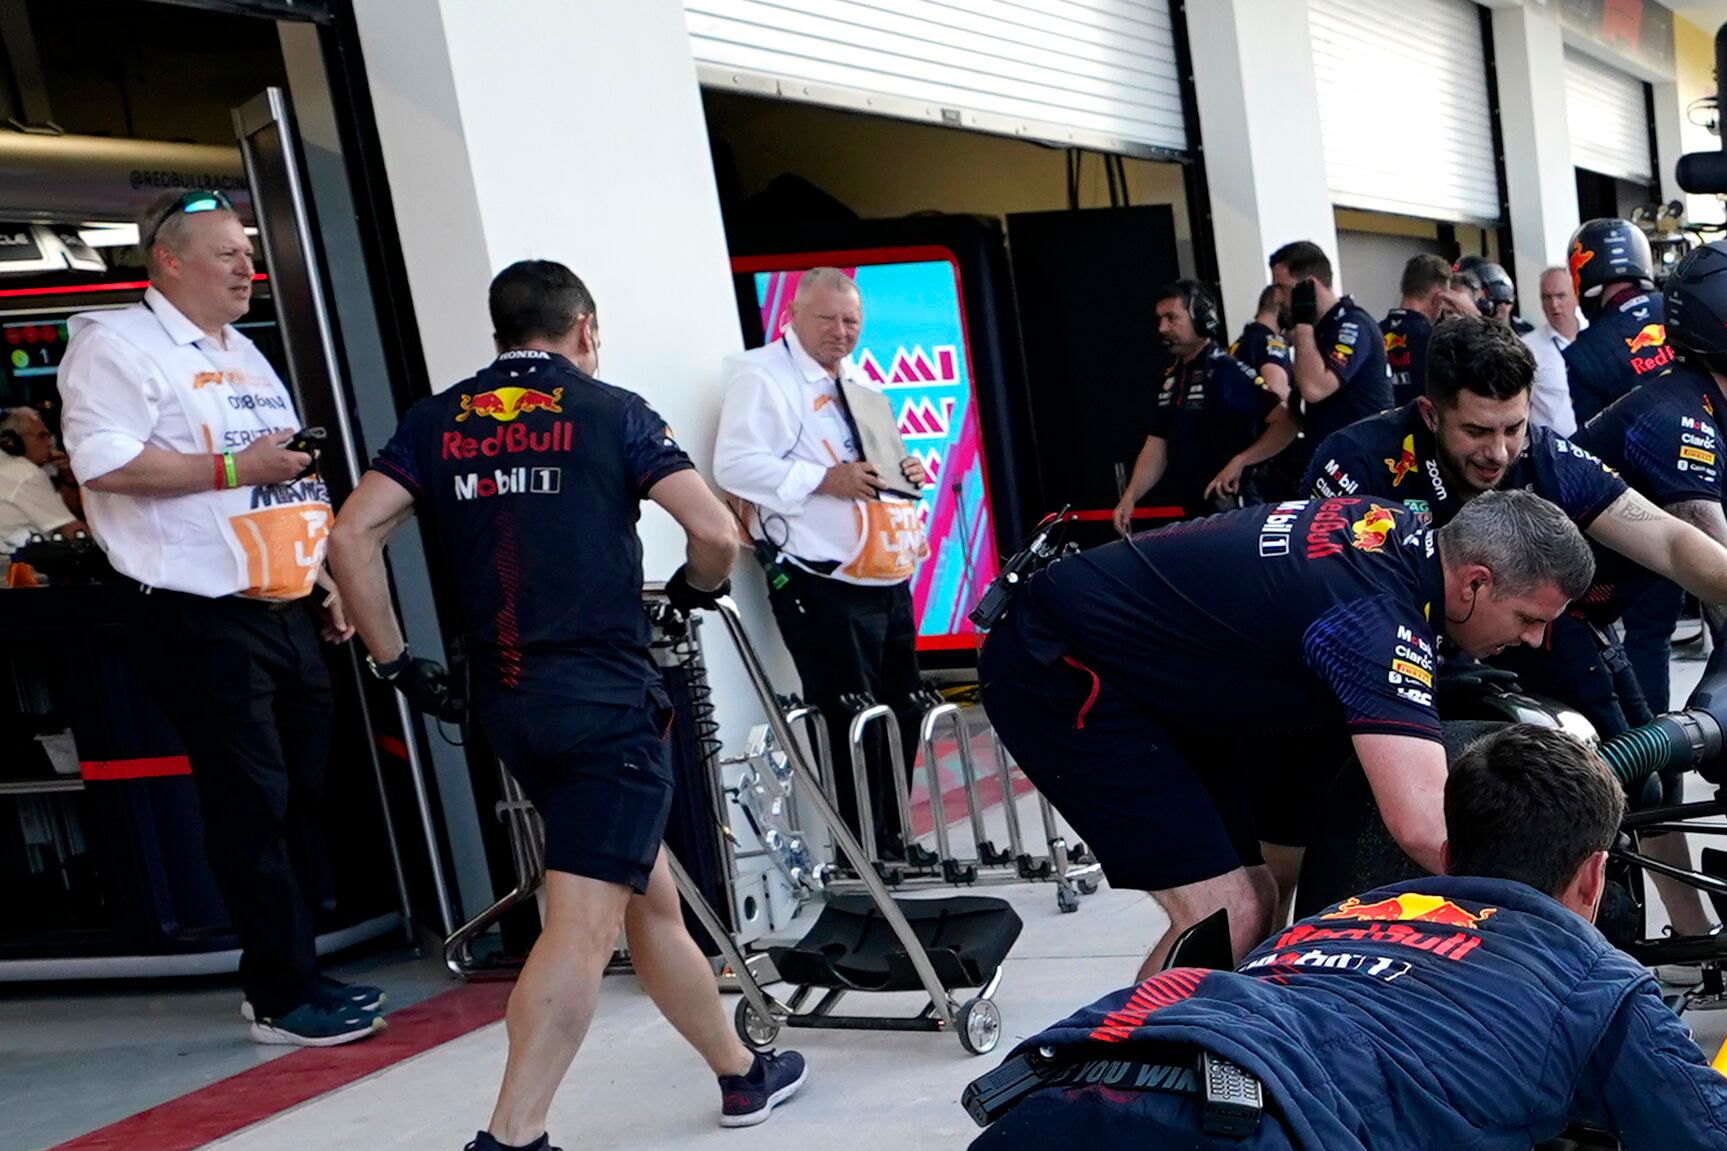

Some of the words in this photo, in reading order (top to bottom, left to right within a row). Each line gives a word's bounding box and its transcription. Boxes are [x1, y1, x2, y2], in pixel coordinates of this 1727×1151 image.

[442, 426, 503, 460] Red
[506, 420, 573, 453] Bull
[455, 468, 526, 500] Mobil
[1324, 459, 1359, 495] Mobil
[1426, 459, 1447, 501] zoom
